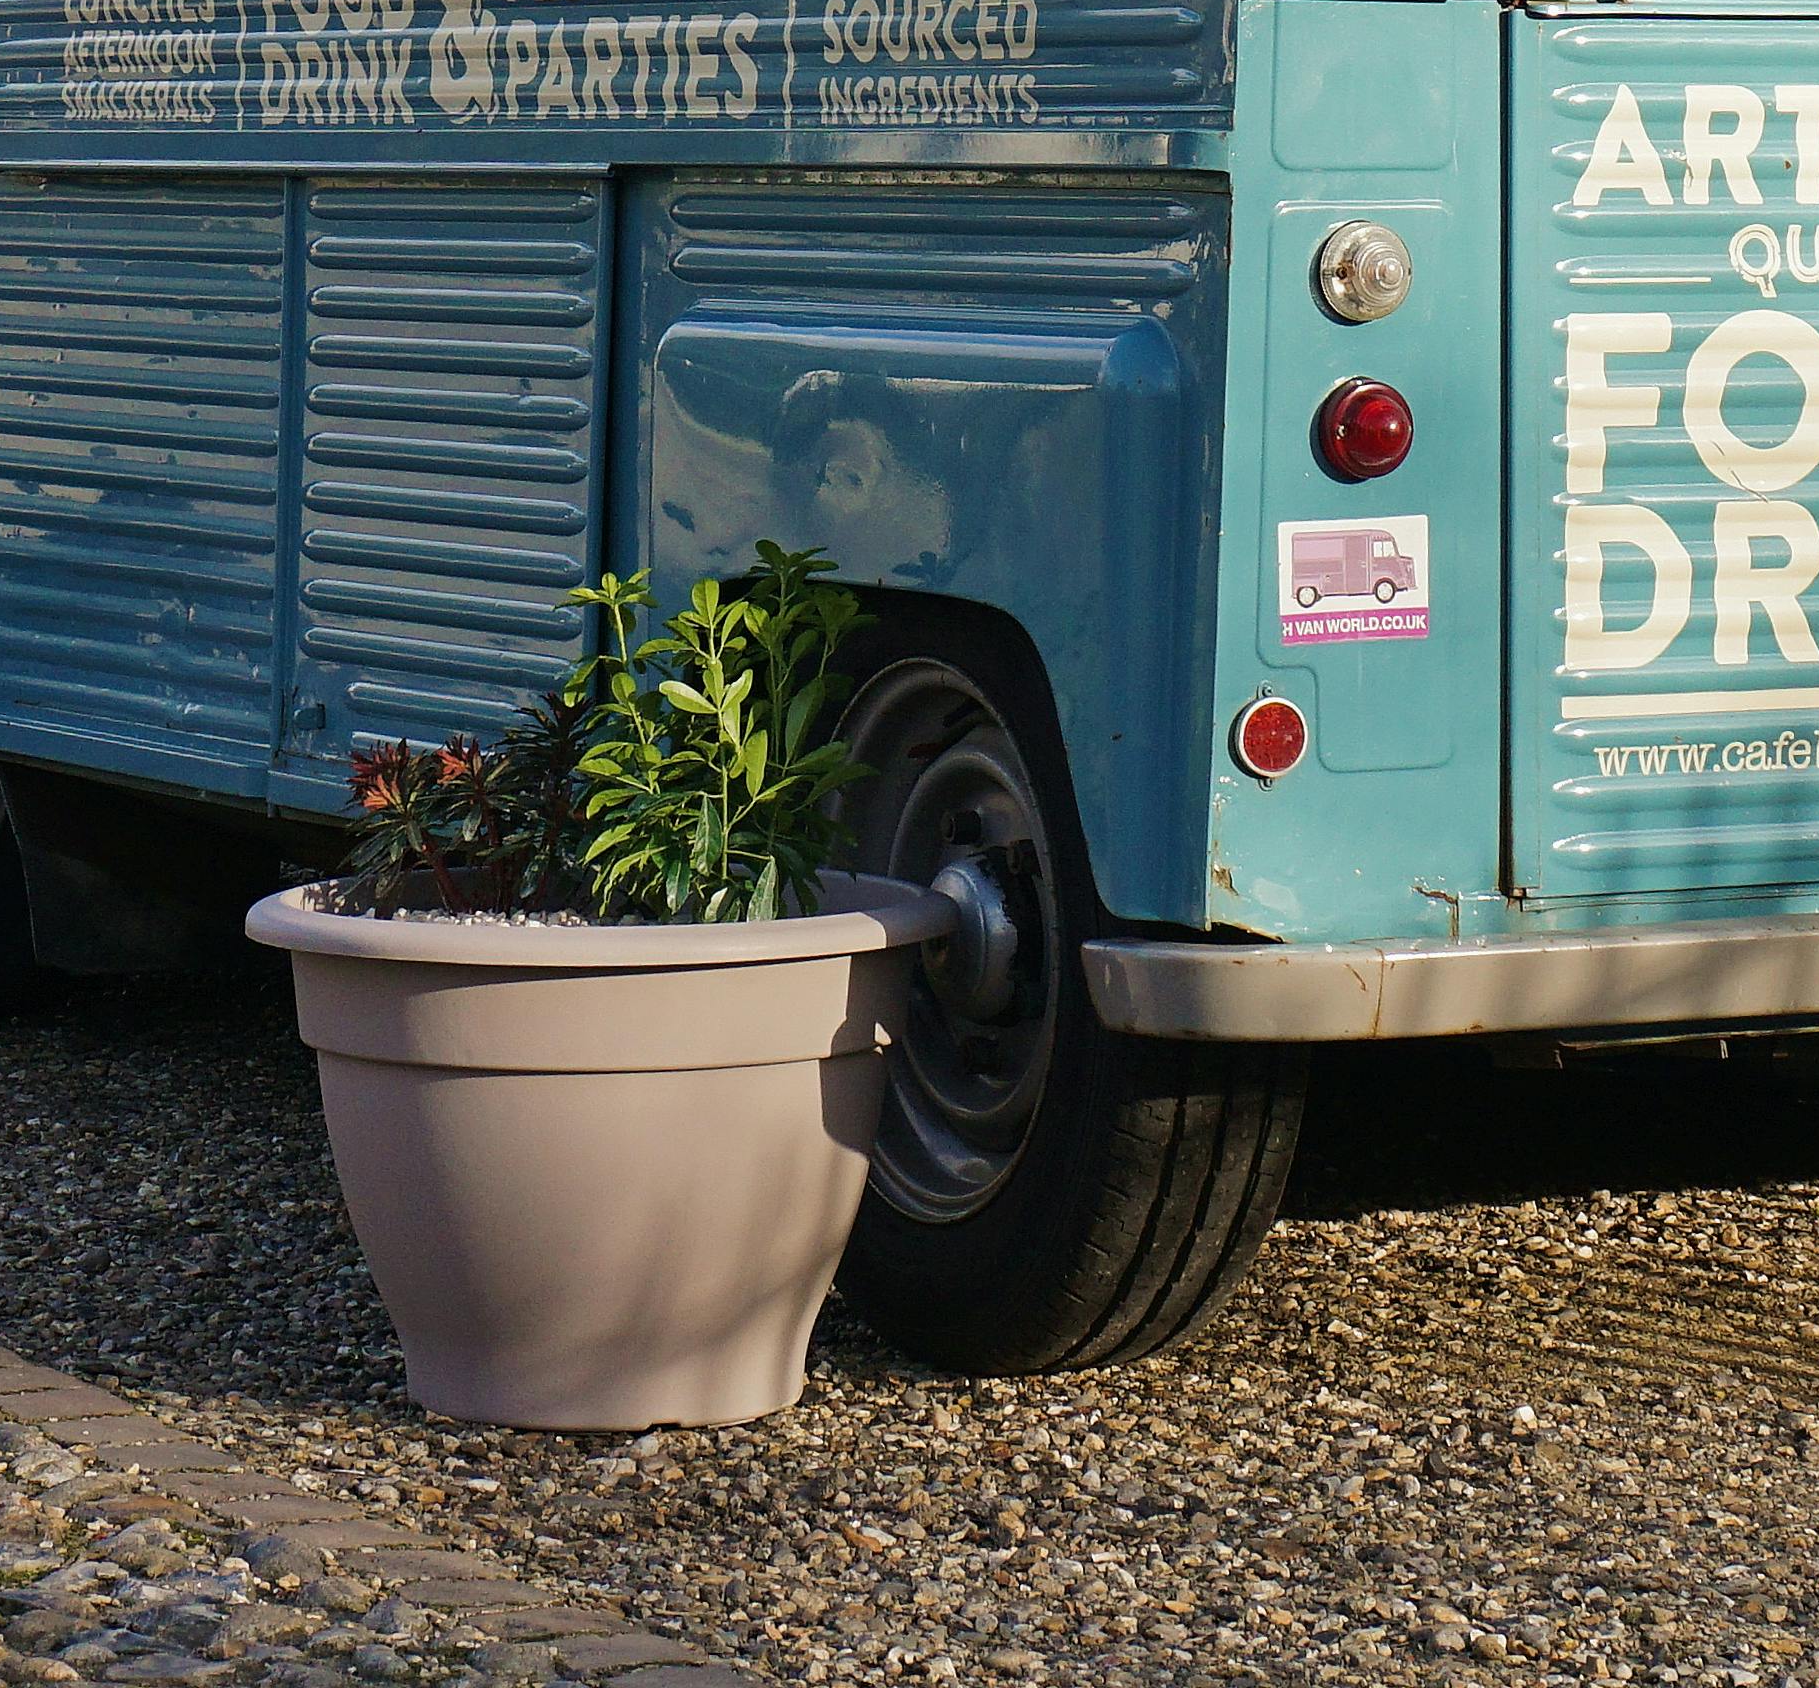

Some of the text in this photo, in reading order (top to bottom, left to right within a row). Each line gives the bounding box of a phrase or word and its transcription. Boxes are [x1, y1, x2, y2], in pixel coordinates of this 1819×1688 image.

[62, 29, 217, 75] AFTERNOON
[505, 12, 760, 120] PARTIES
[260, 38, 415, 126] DRINK
[819, 73, 1040, 126] INGREDIENTS
[1295, 620, 1324, 636] VAN
[1327, 614, 1427, 633] WORLD.CO.UK
